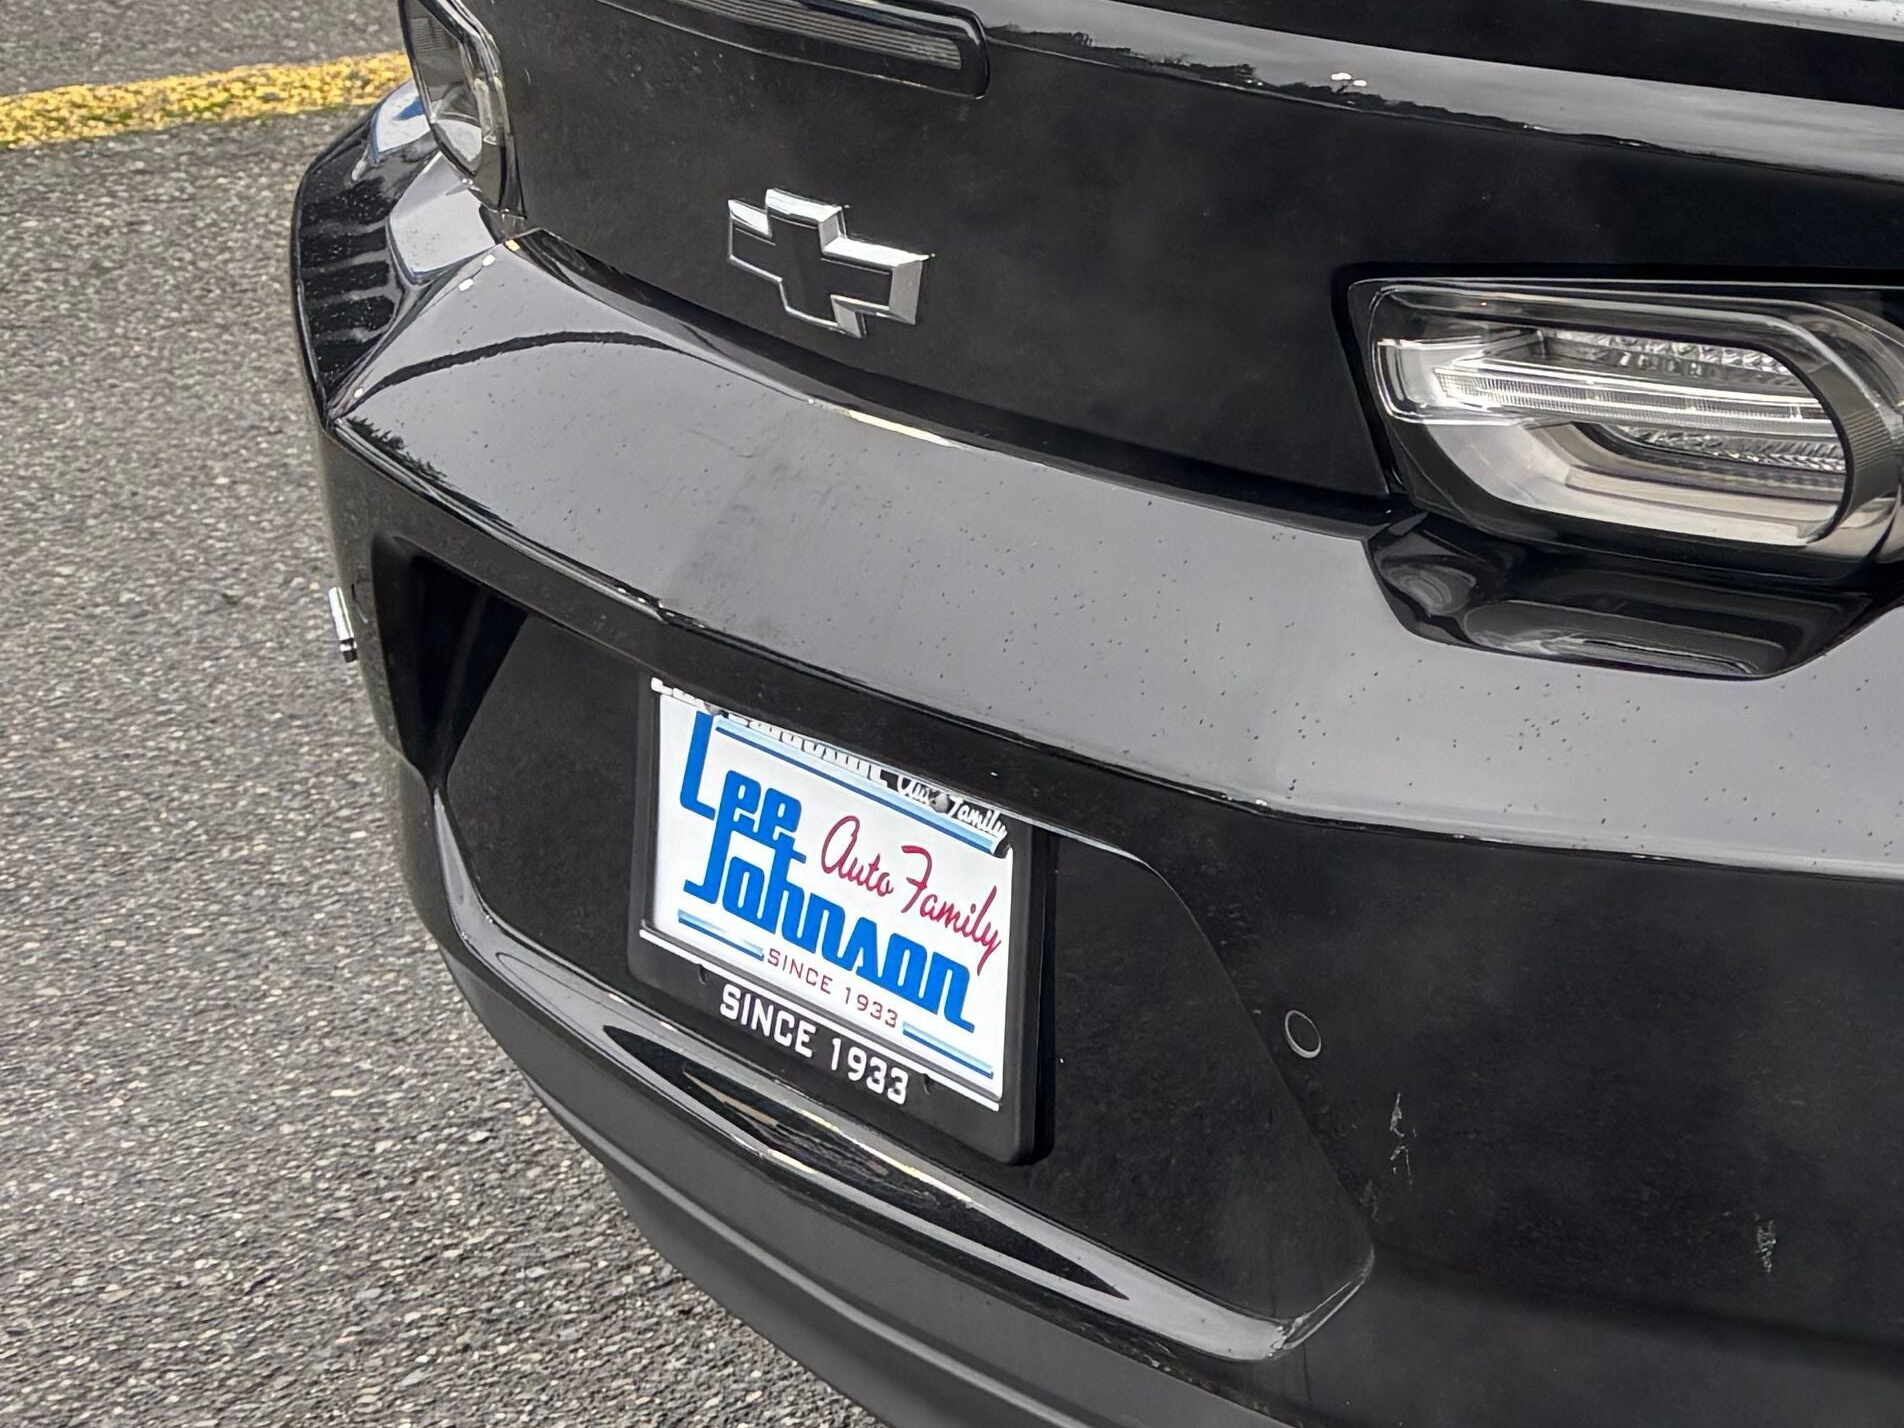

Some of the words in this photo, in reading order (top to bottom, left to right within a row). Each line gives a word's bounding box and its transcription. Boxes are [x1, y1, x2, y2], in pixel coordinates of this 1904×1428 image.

[680, 710, 802, 840] Lee
[683, 814, 975, 1034] Johnson
[820, 815, 893, 897] Auto
[901, 845, 1001, 976] Family
[720, 984, 815, 1059] SINCE
[831, 1038, 910, 1105] 1933
[767, 947, 832, 994] SINCE
[844, 986, 899, 1029] 1933
